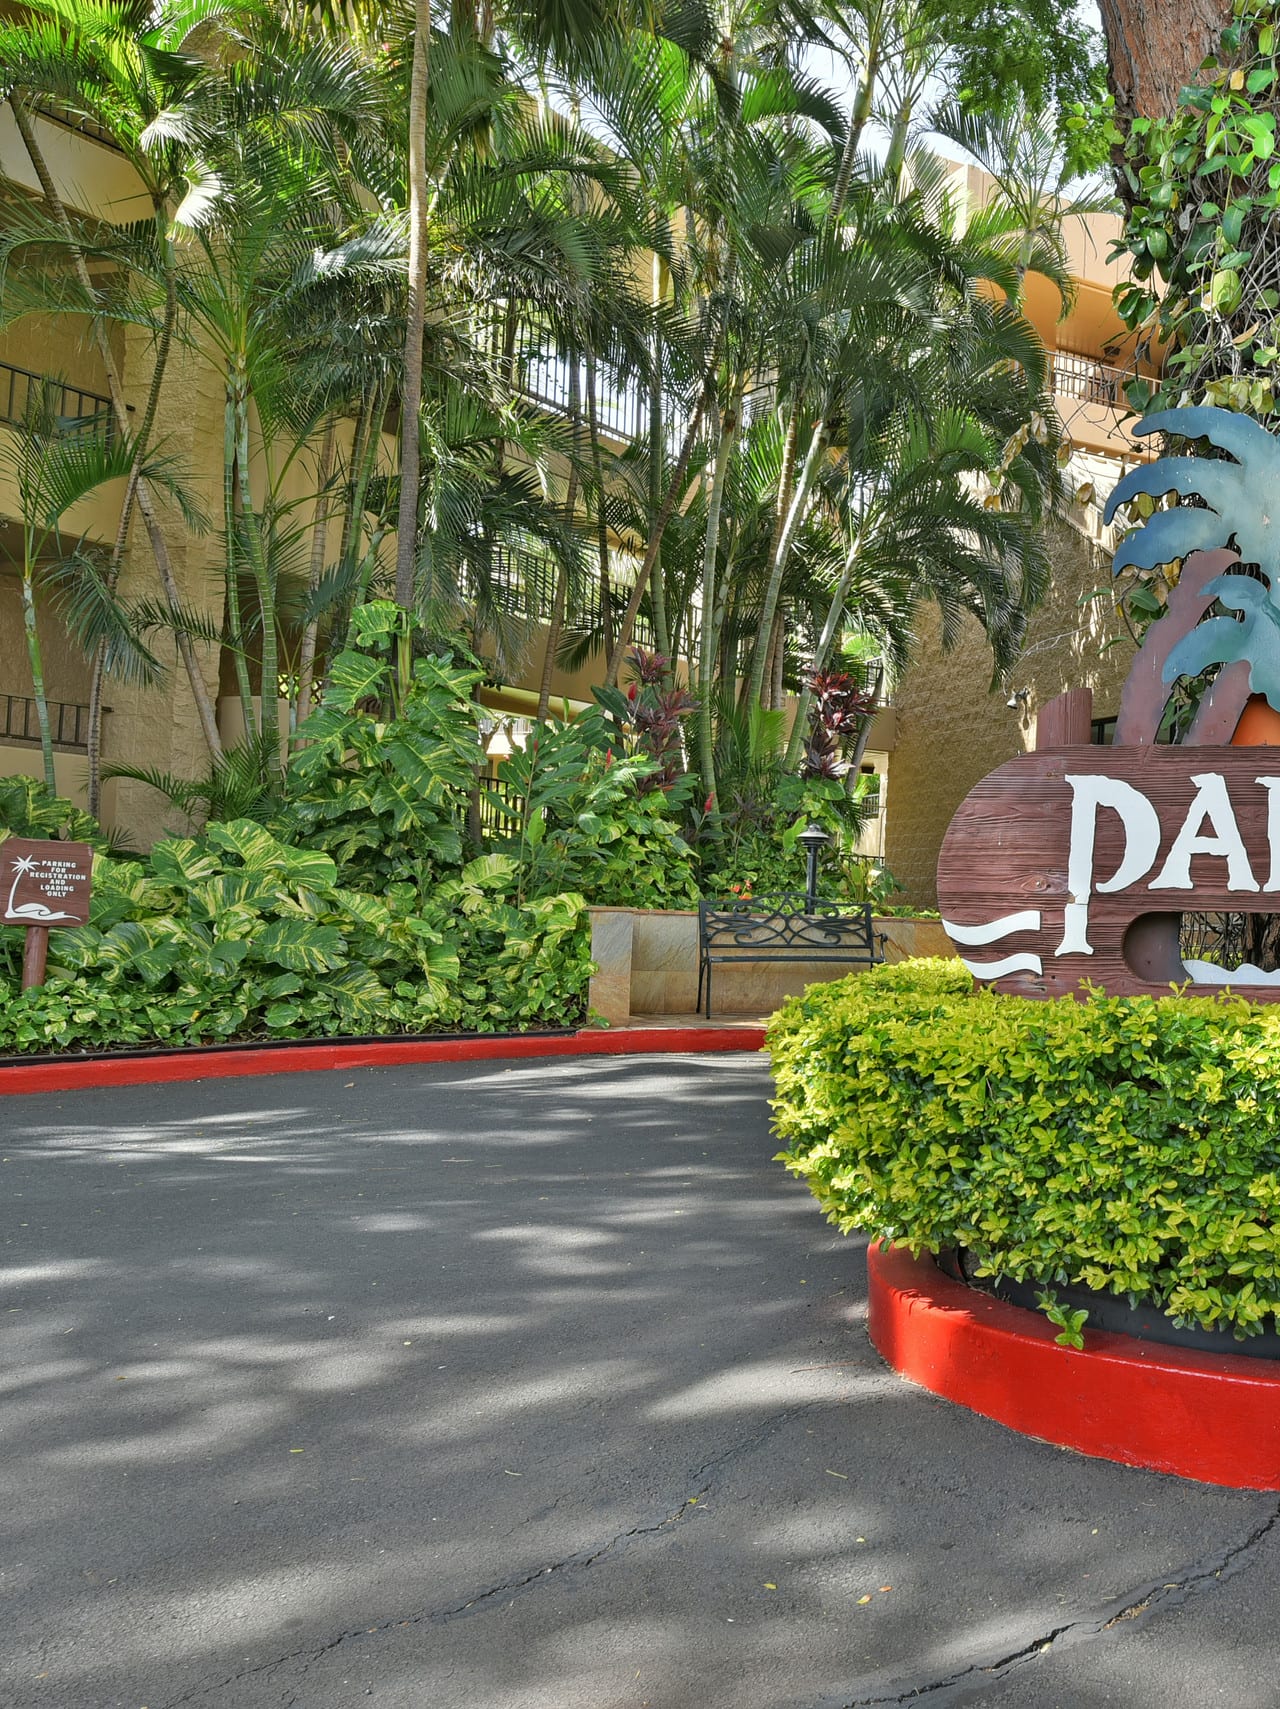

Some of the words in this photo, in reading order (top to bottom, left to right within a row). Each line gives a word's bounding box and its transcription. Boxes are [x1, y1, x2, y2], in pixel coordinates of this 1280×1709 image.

[41, 860, 77, 868] PARKING
[30, 871, 87, 880] REGISTRATION
[40, 884, 75, 892] LOADING
